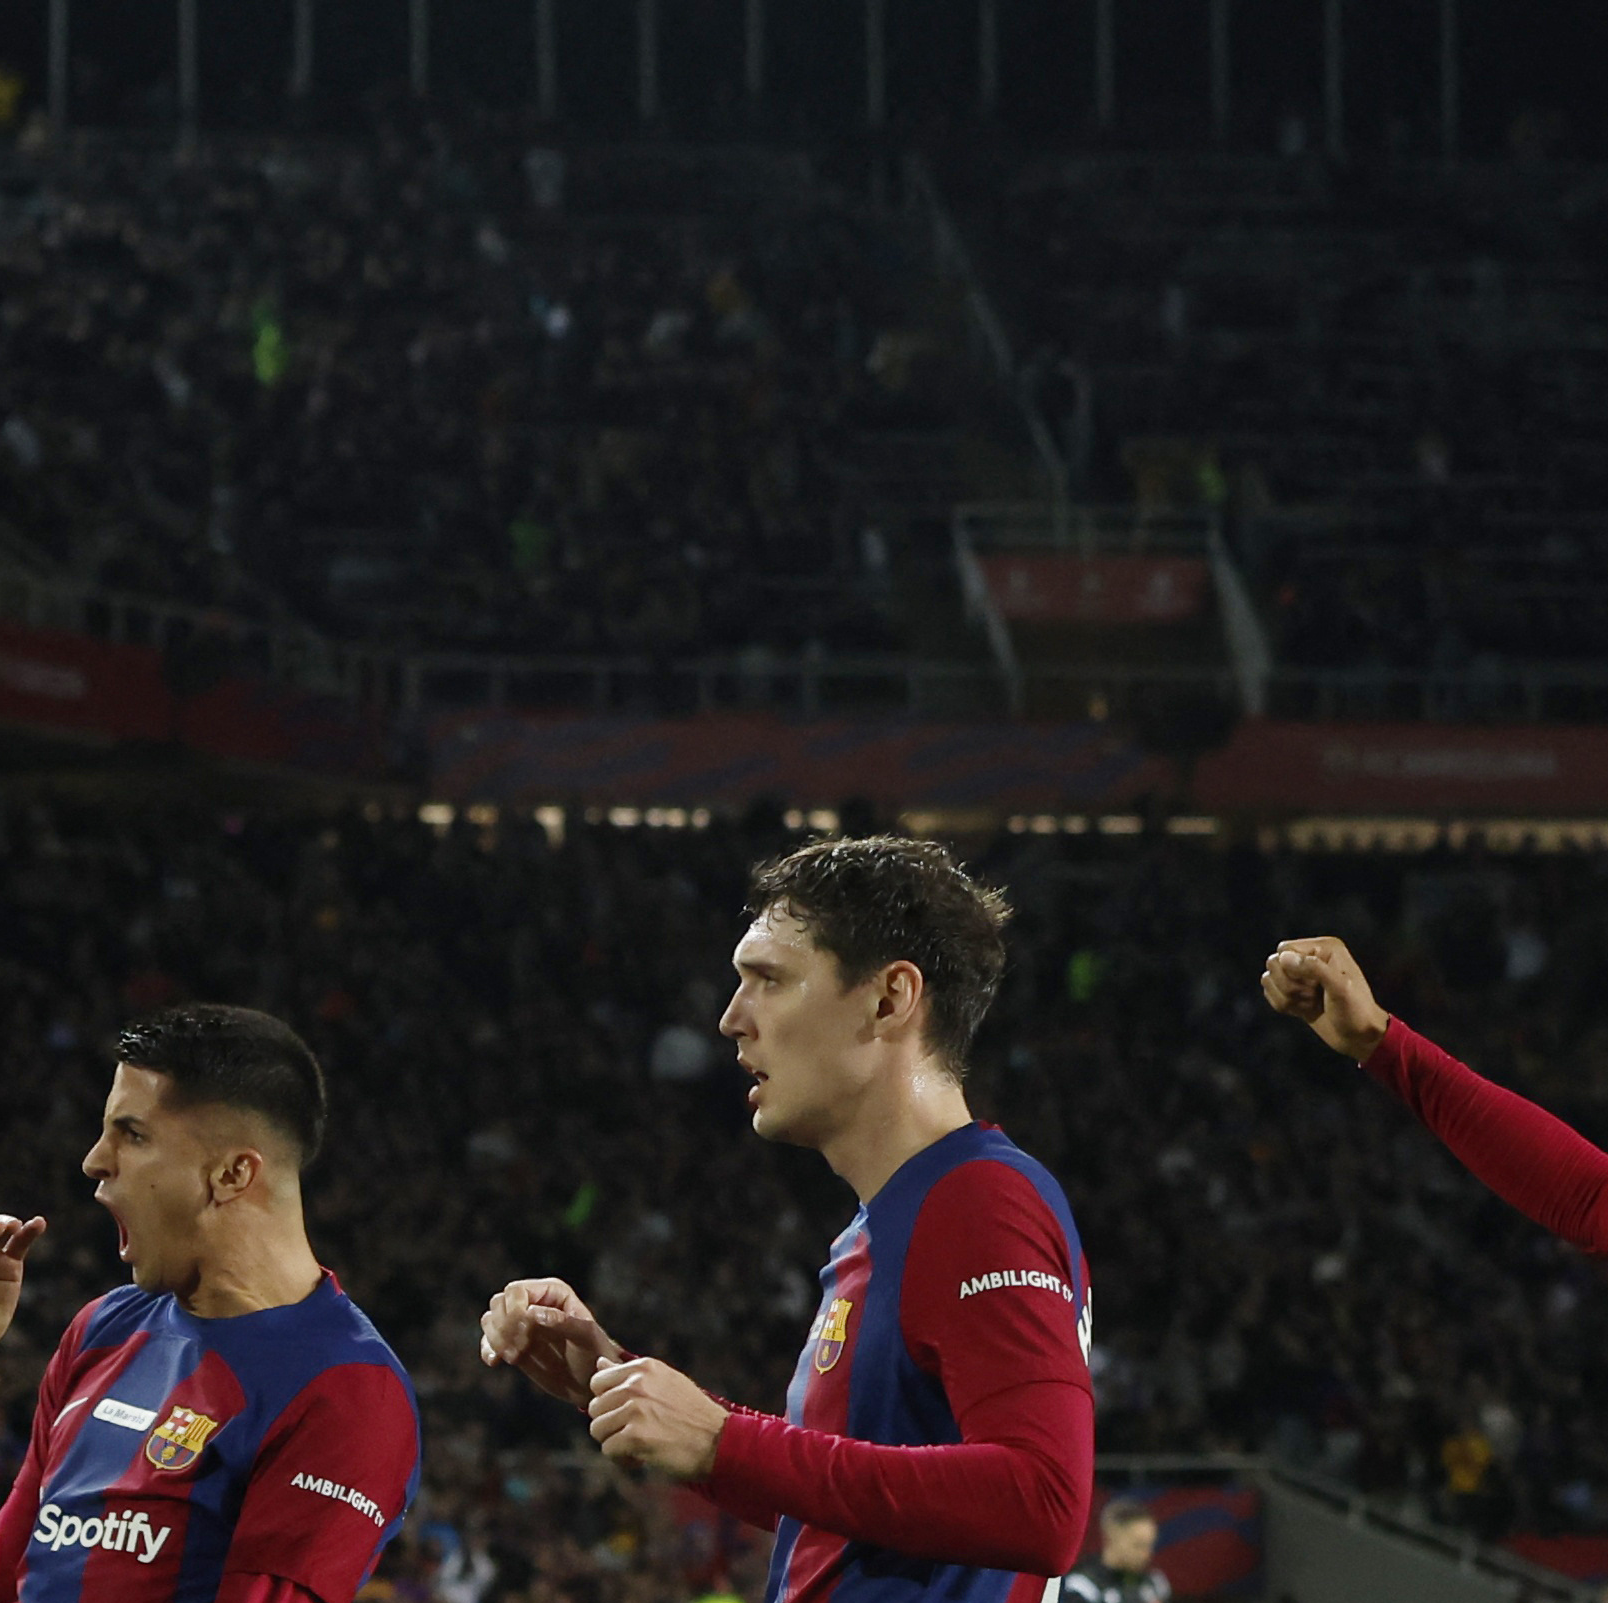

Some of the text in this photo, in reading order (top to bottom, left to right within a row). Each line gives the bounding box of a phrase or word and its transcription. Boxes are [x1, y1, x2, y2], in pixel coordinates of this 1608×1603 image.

[960, 1269, 1061, 1299] AMBILIGHT
[290, 1472, 385, 1528] AMBILIGHT tv
[33, 1503, 171, 1564] Spotify
